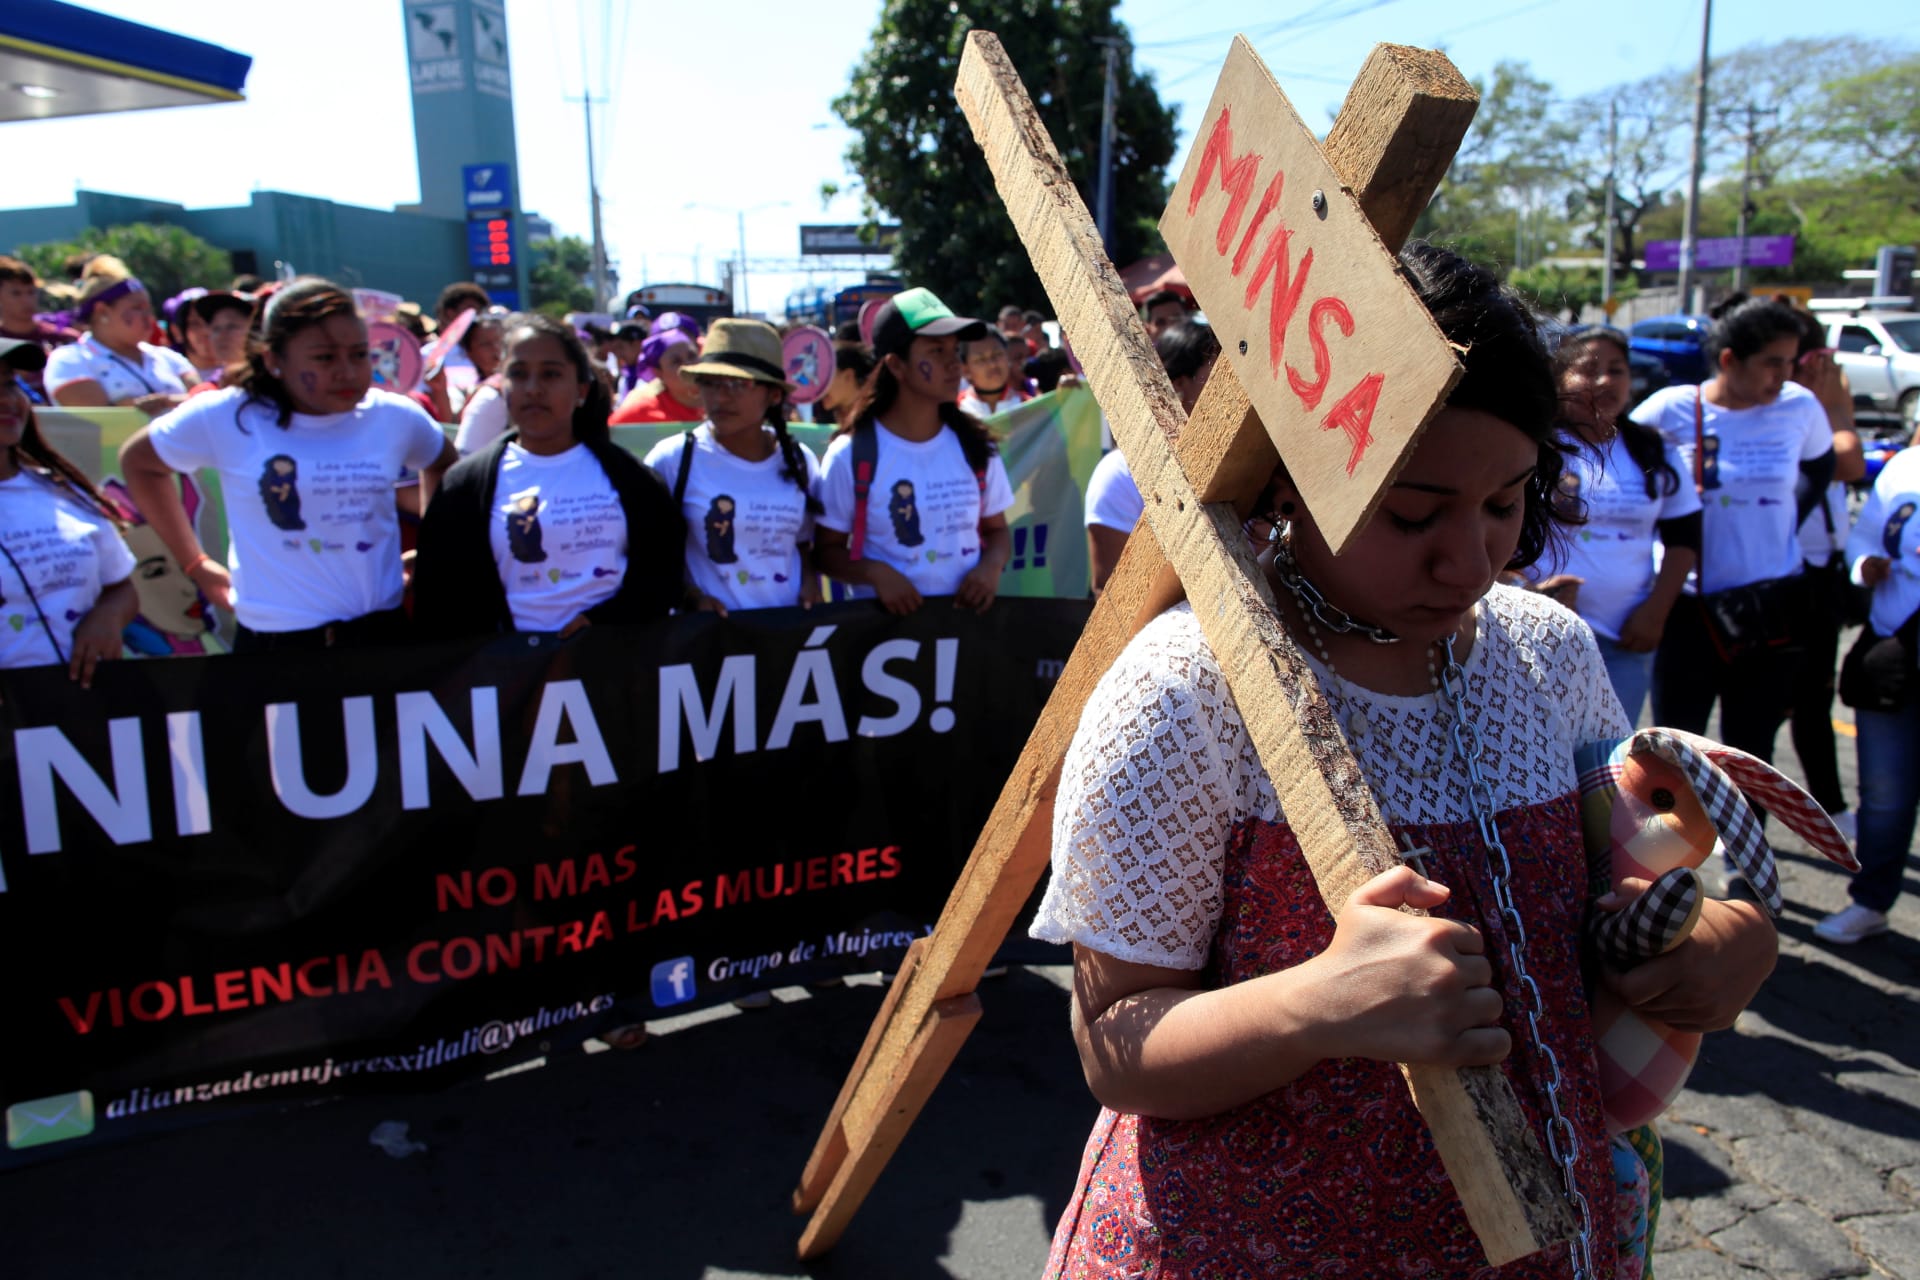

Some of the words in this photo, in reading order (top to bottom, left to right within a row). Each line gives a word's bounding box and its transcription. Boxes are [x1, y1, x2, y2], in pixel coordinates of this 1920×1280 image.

[1187, 104, 1385, 478] MINSA
[14, 710, 211, 855] NI
[265, 680, 619, 819] UNA
[657, 624, 960, 774] MÁS!
[58, 949, 392, 1035] VIOLENCIA
[406, 911, 613, 983] CONTRA
[627, 881, 703, 933] LAS
[714, 846, 902, 909] MUJERES
[435, 866, 516, 912] NO
[533, 845, 638, 902] MAS
[708, 951, 784, 982] Grupo
[788, 941, 816, 964] de
[822, 928, 915, 958] Mujeres
[106, 991, 615, 1119] alianzademujeresxitlali@yahoo.es
